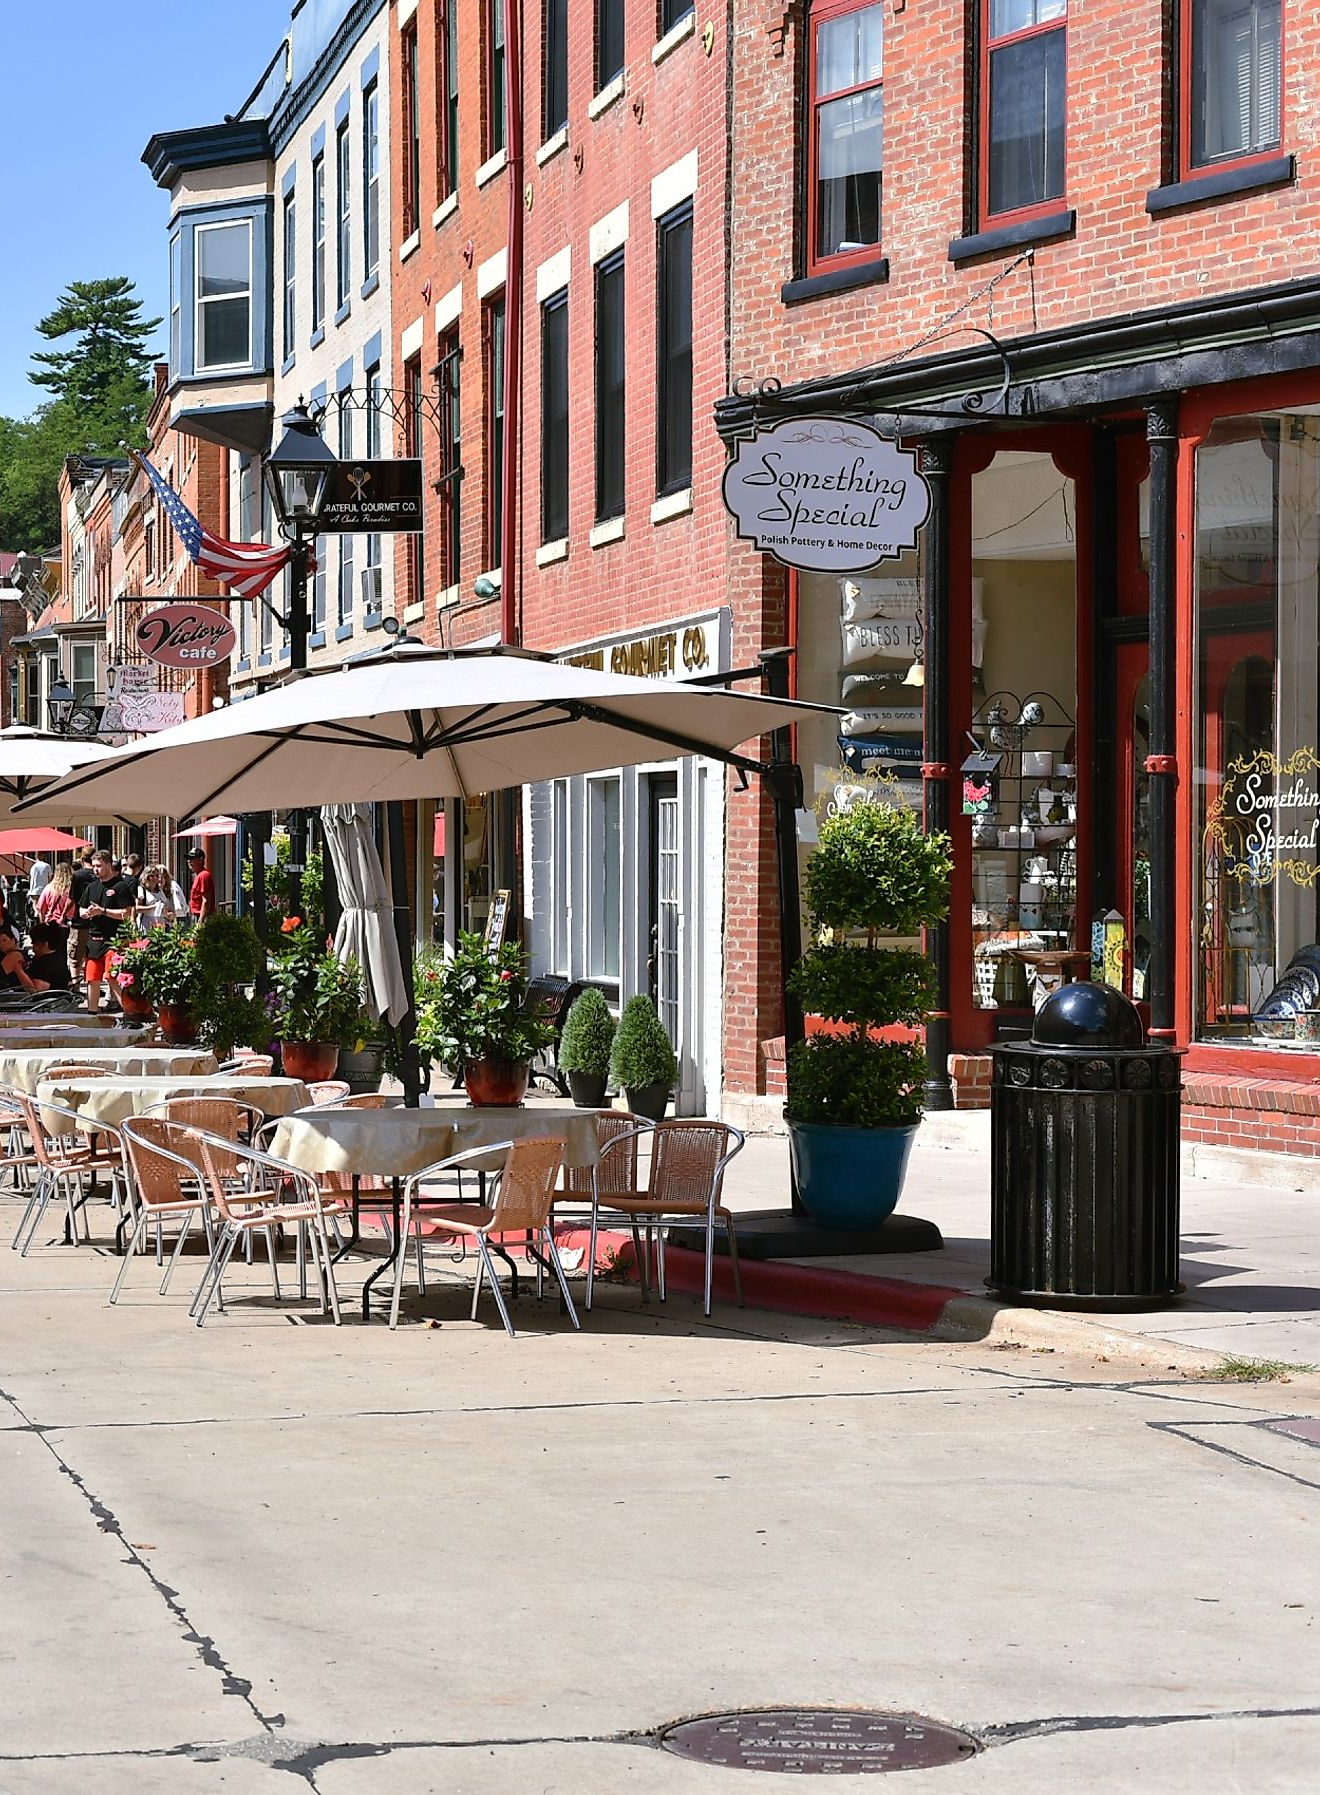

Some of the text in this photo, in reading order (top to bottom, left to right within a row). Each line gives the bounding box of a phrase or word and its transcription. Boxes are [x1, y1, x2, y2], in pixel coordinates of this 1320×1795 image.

[742, 452, 907, 511] Something
[323, 503, 359, 513] RATEFUL
[361, 502, 400, 512] GOURMET
[402, 502, 418, 511] CO.
[757, 488, 886, 535] Special
[761, 534, 893, 551] Polish Pottery & Home Decor
[138, 616, 232, 656] Victory
[179, 646, 217, 659] cafe
[853, 673, 891, 682] WELCOME
[861, 744, 890, 756] meet
[893, 747, 911, 756] me
[1236, 773, 1320, 814] Somethin
[1246, 813, 1320, 861] Special
